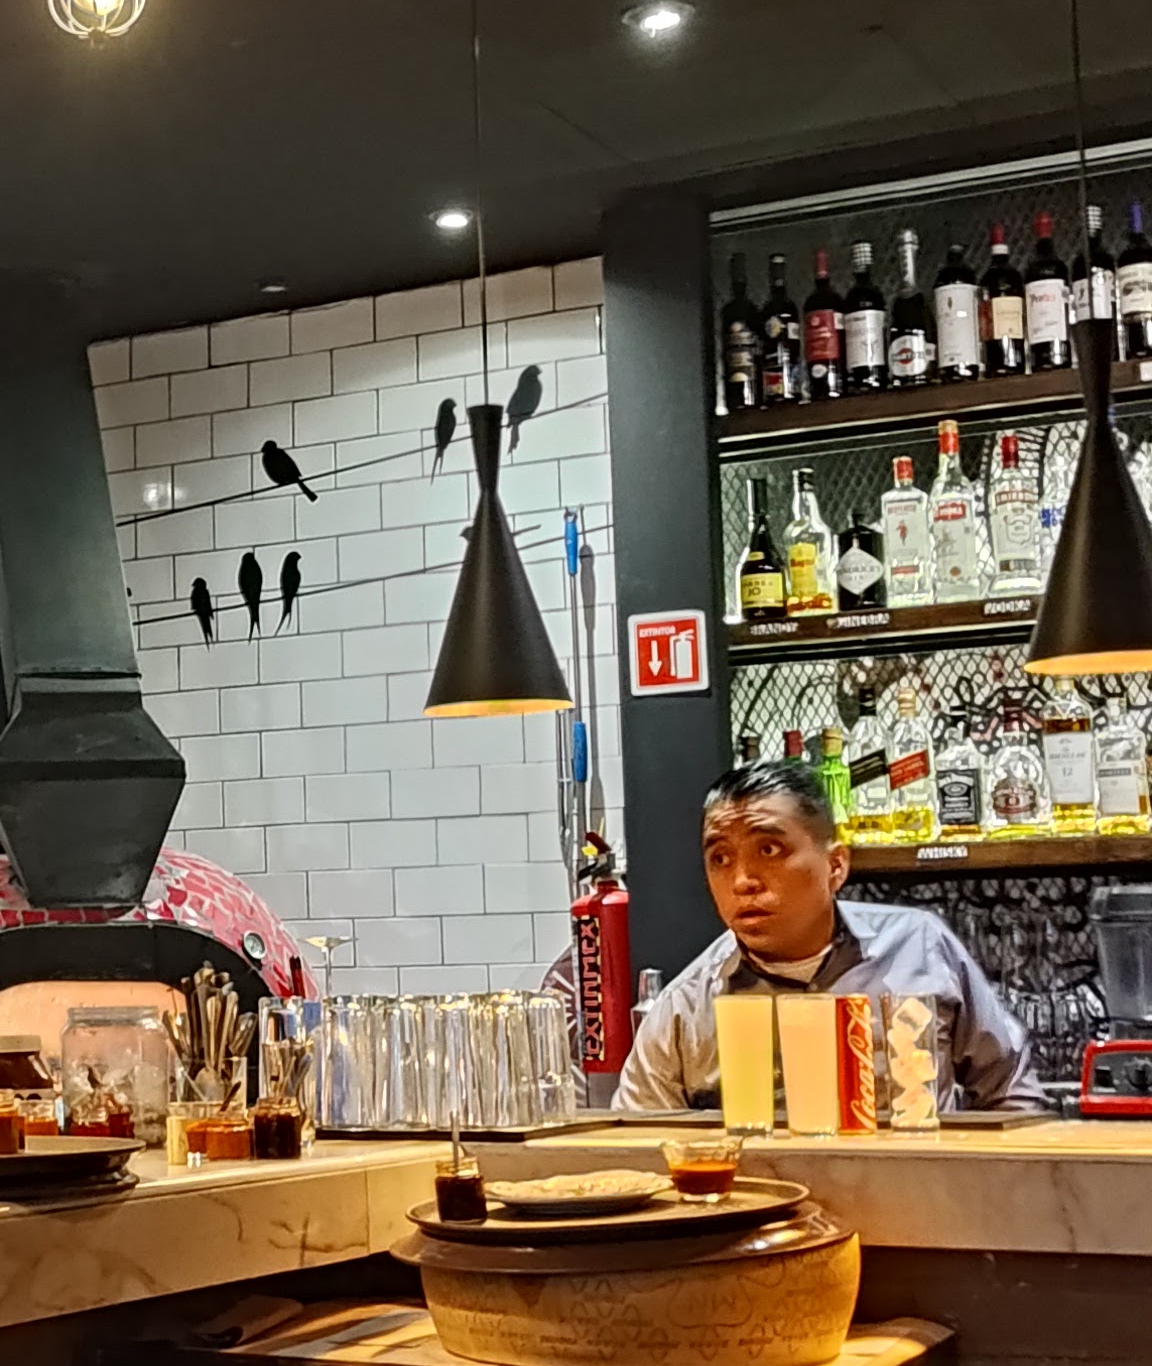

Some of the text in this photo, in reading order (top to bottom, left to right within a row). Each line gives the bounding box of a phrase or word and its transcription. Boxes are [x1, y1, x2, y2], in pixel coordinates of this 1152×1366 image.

[984, 599, 1032, 615] VODKA
[750, 621, 799, 636] BRANDY
[917, 845, 969, 860] WHISKY
